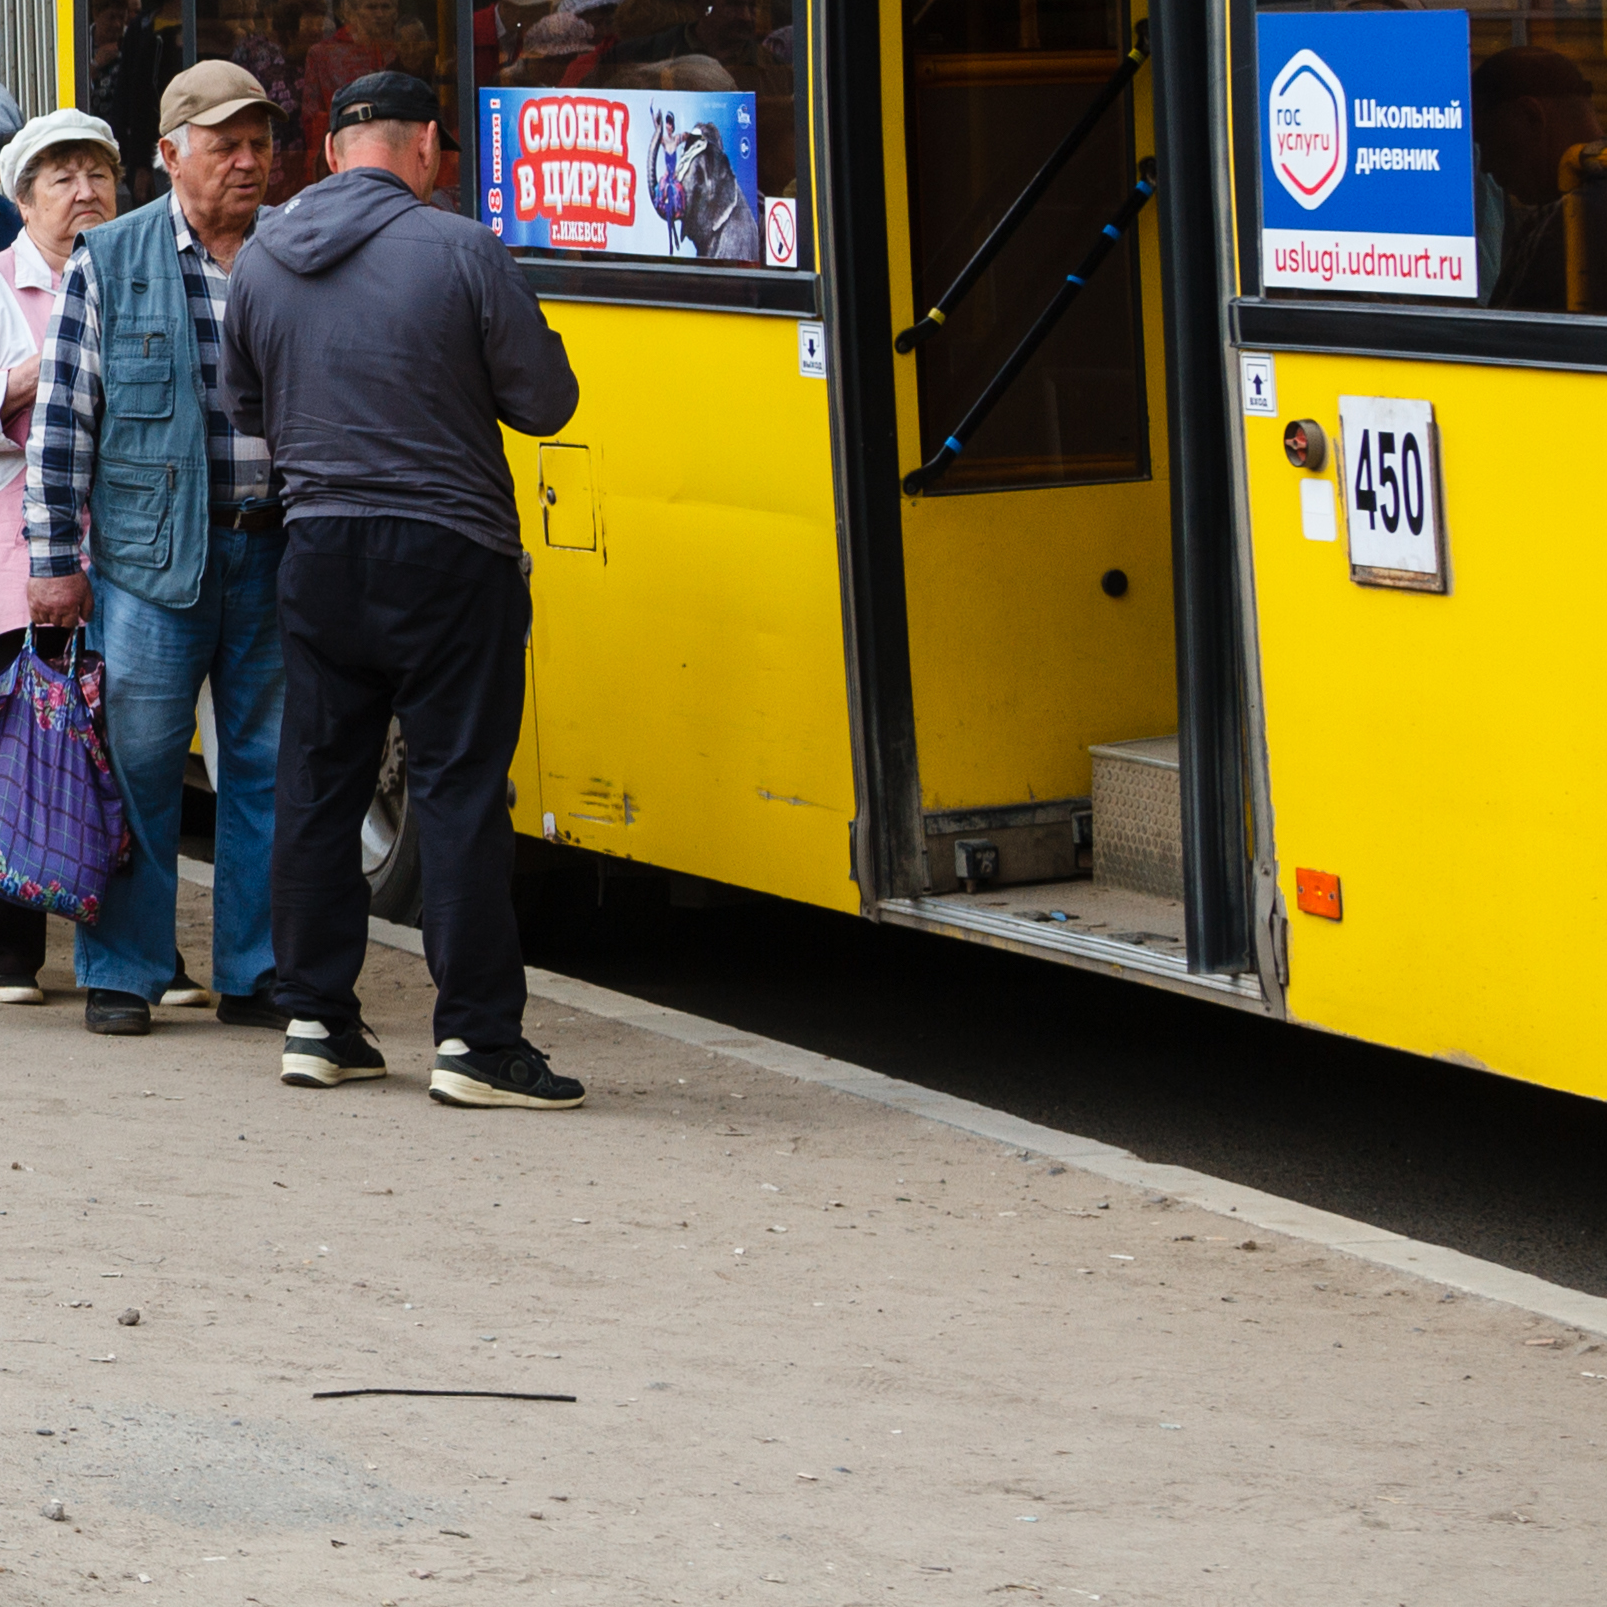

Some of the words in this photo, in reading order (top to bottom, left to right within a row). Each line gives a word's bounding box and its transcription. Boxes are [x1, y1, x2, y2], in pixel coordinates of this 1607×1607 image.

[1277, 108, 1302, 126] гос
[1354, 99, 1463, 129] Школьный
[523, 103, 624, 157] СЛОНЫ
[1277, 133, 1330, 157] услуги
[1355, 147, 1441, 175] дневник
[489, 188, 503, 213] 8
[518, 165, 536, 212] В
[542, 161, 632, 216] ЦИРКЕ
[552, 220, 606, 243] г.ИЖЕВСК
[1275, 241, 1463, 282] uslugi.udmurt.ru
[1354, 428, 1425, 536] 450
